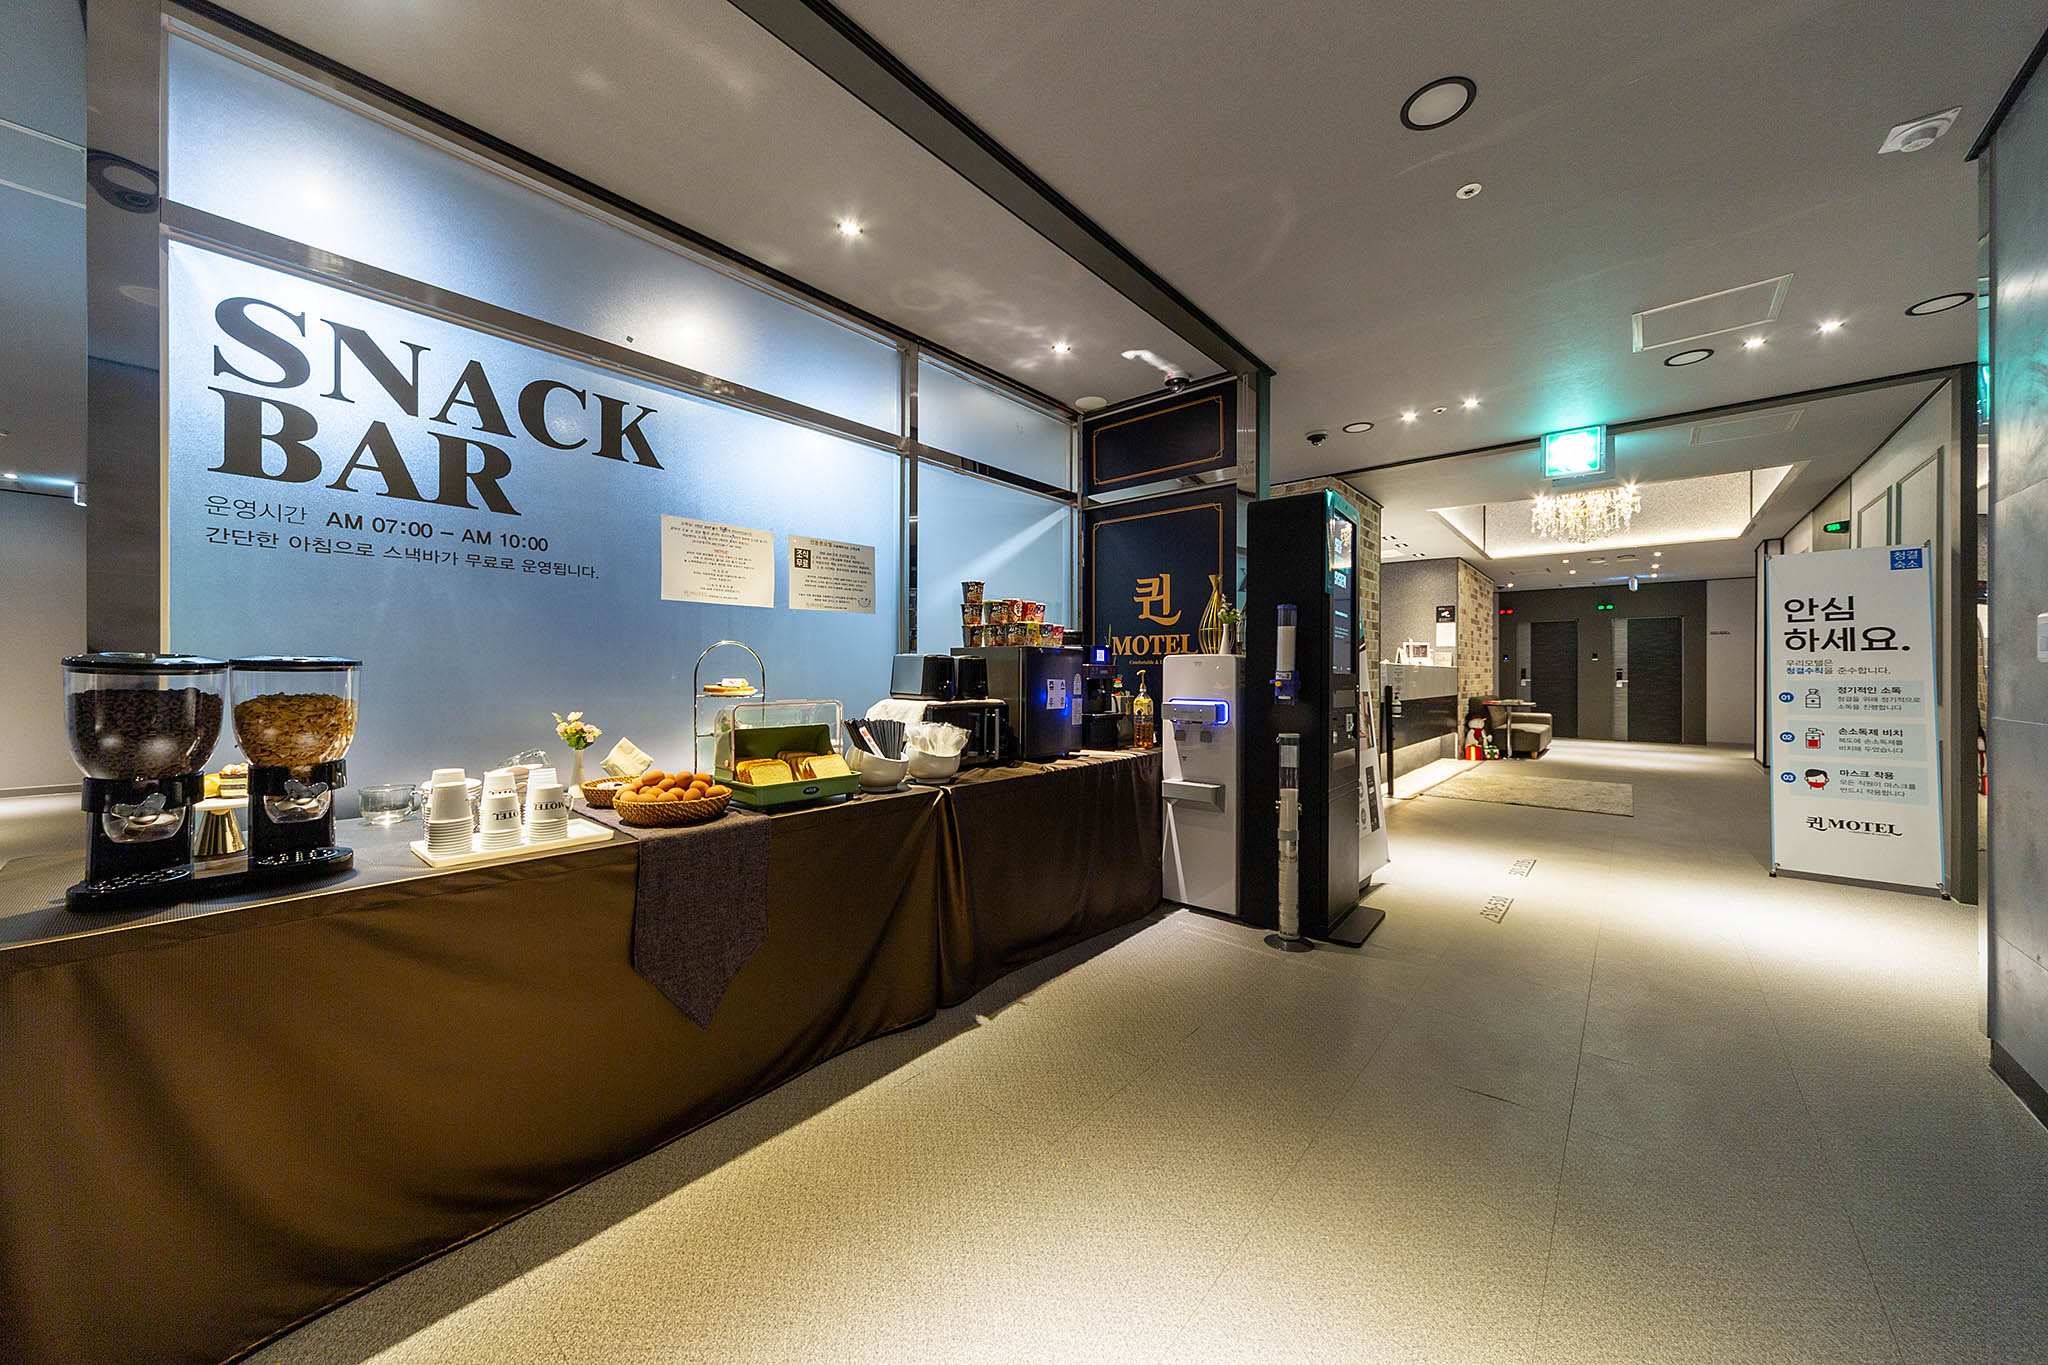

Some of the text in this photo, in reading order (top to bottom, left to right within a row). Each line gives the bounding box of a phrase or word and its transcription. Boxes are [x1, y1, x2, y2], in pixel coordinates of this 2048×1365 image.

[213, 296, 664, 471] SNACK
[207, 385, 521, 516] BAR
[204, 495, 308, 527] 운영시간
[326, 511, 364, 531] AM
[372, 516, 433, 539] 07:00
[461, 528, 492, 546] AM
[500, 533, 549, 552] 10:00
[204, 525, 600, 581] 간단한 아침으로 스낵바가 무료로 운영됩니다.
[1893, 550, 1919, 560] 청결
[1133, 573, 1182, 626] 퀸
[1784, 596, 1855, 623] 안심
[1112, 634, 1198, 655] MOTEL
[1784, 626, 1911, 653] 하세요.
[1786, 659, 1833, 667] 우리모텔은
[1837, 686, 1902, 695] 정기적인 소독
[1838, 727, 1904, 737] 손소독제 비치
[1839, 769, 1895, 780] 마스크 착용
[1806, 816, 1828, 831] 퀸
[1828, 818, 1903, 836] MOTEL
